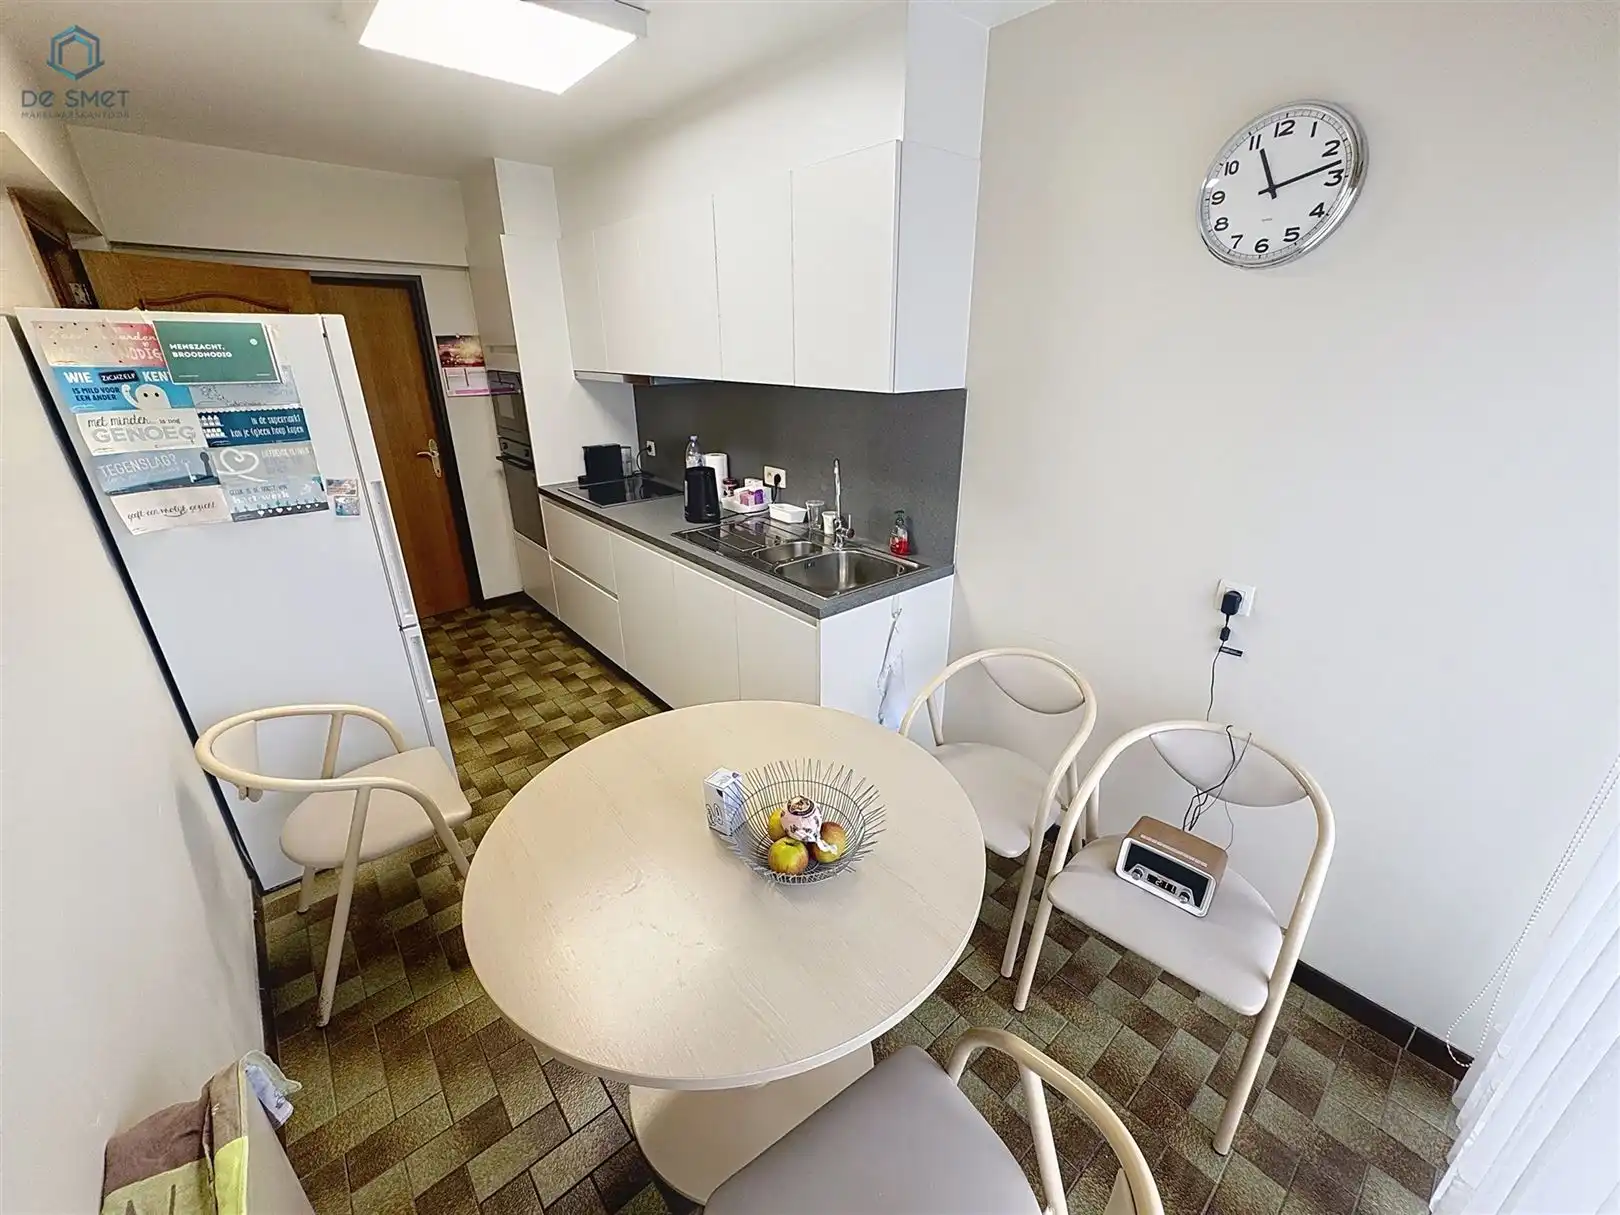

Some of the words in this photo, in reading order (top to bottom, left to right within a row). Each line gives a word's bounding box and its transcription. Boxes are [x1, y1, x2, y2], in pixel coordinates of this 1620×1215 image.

[1273, 119, 1296, 138] 12
[1310, 121, 1318, 138] 1
[1249, 134, 1262, 151] 11
[1321, 139, 1341, 157] 2
[1224, 160, 1240, 176] 10
[1323, 168, 1345, 187] 3
[1211, 190, 1226, 205] 9
[1309, 202, 1326, 218] 4
[1214, 216, 1229, 232] 8
[1230, 234, 1244, 249] 7
[1282, 226, 1301, 242] 5
[1254, 238, 1270, 253] 6
[63, 371, 93, 384] WIE
[72, 387, 81, 395] IS
[81, 386, 99, 395] MILD
[98, 386, 121, 394] VOOR
[75, 394, 91, 402] EEN
[91, 425, 196, 443] GENOEG
[98, 451, 177, 477] TEGENSLAG?
